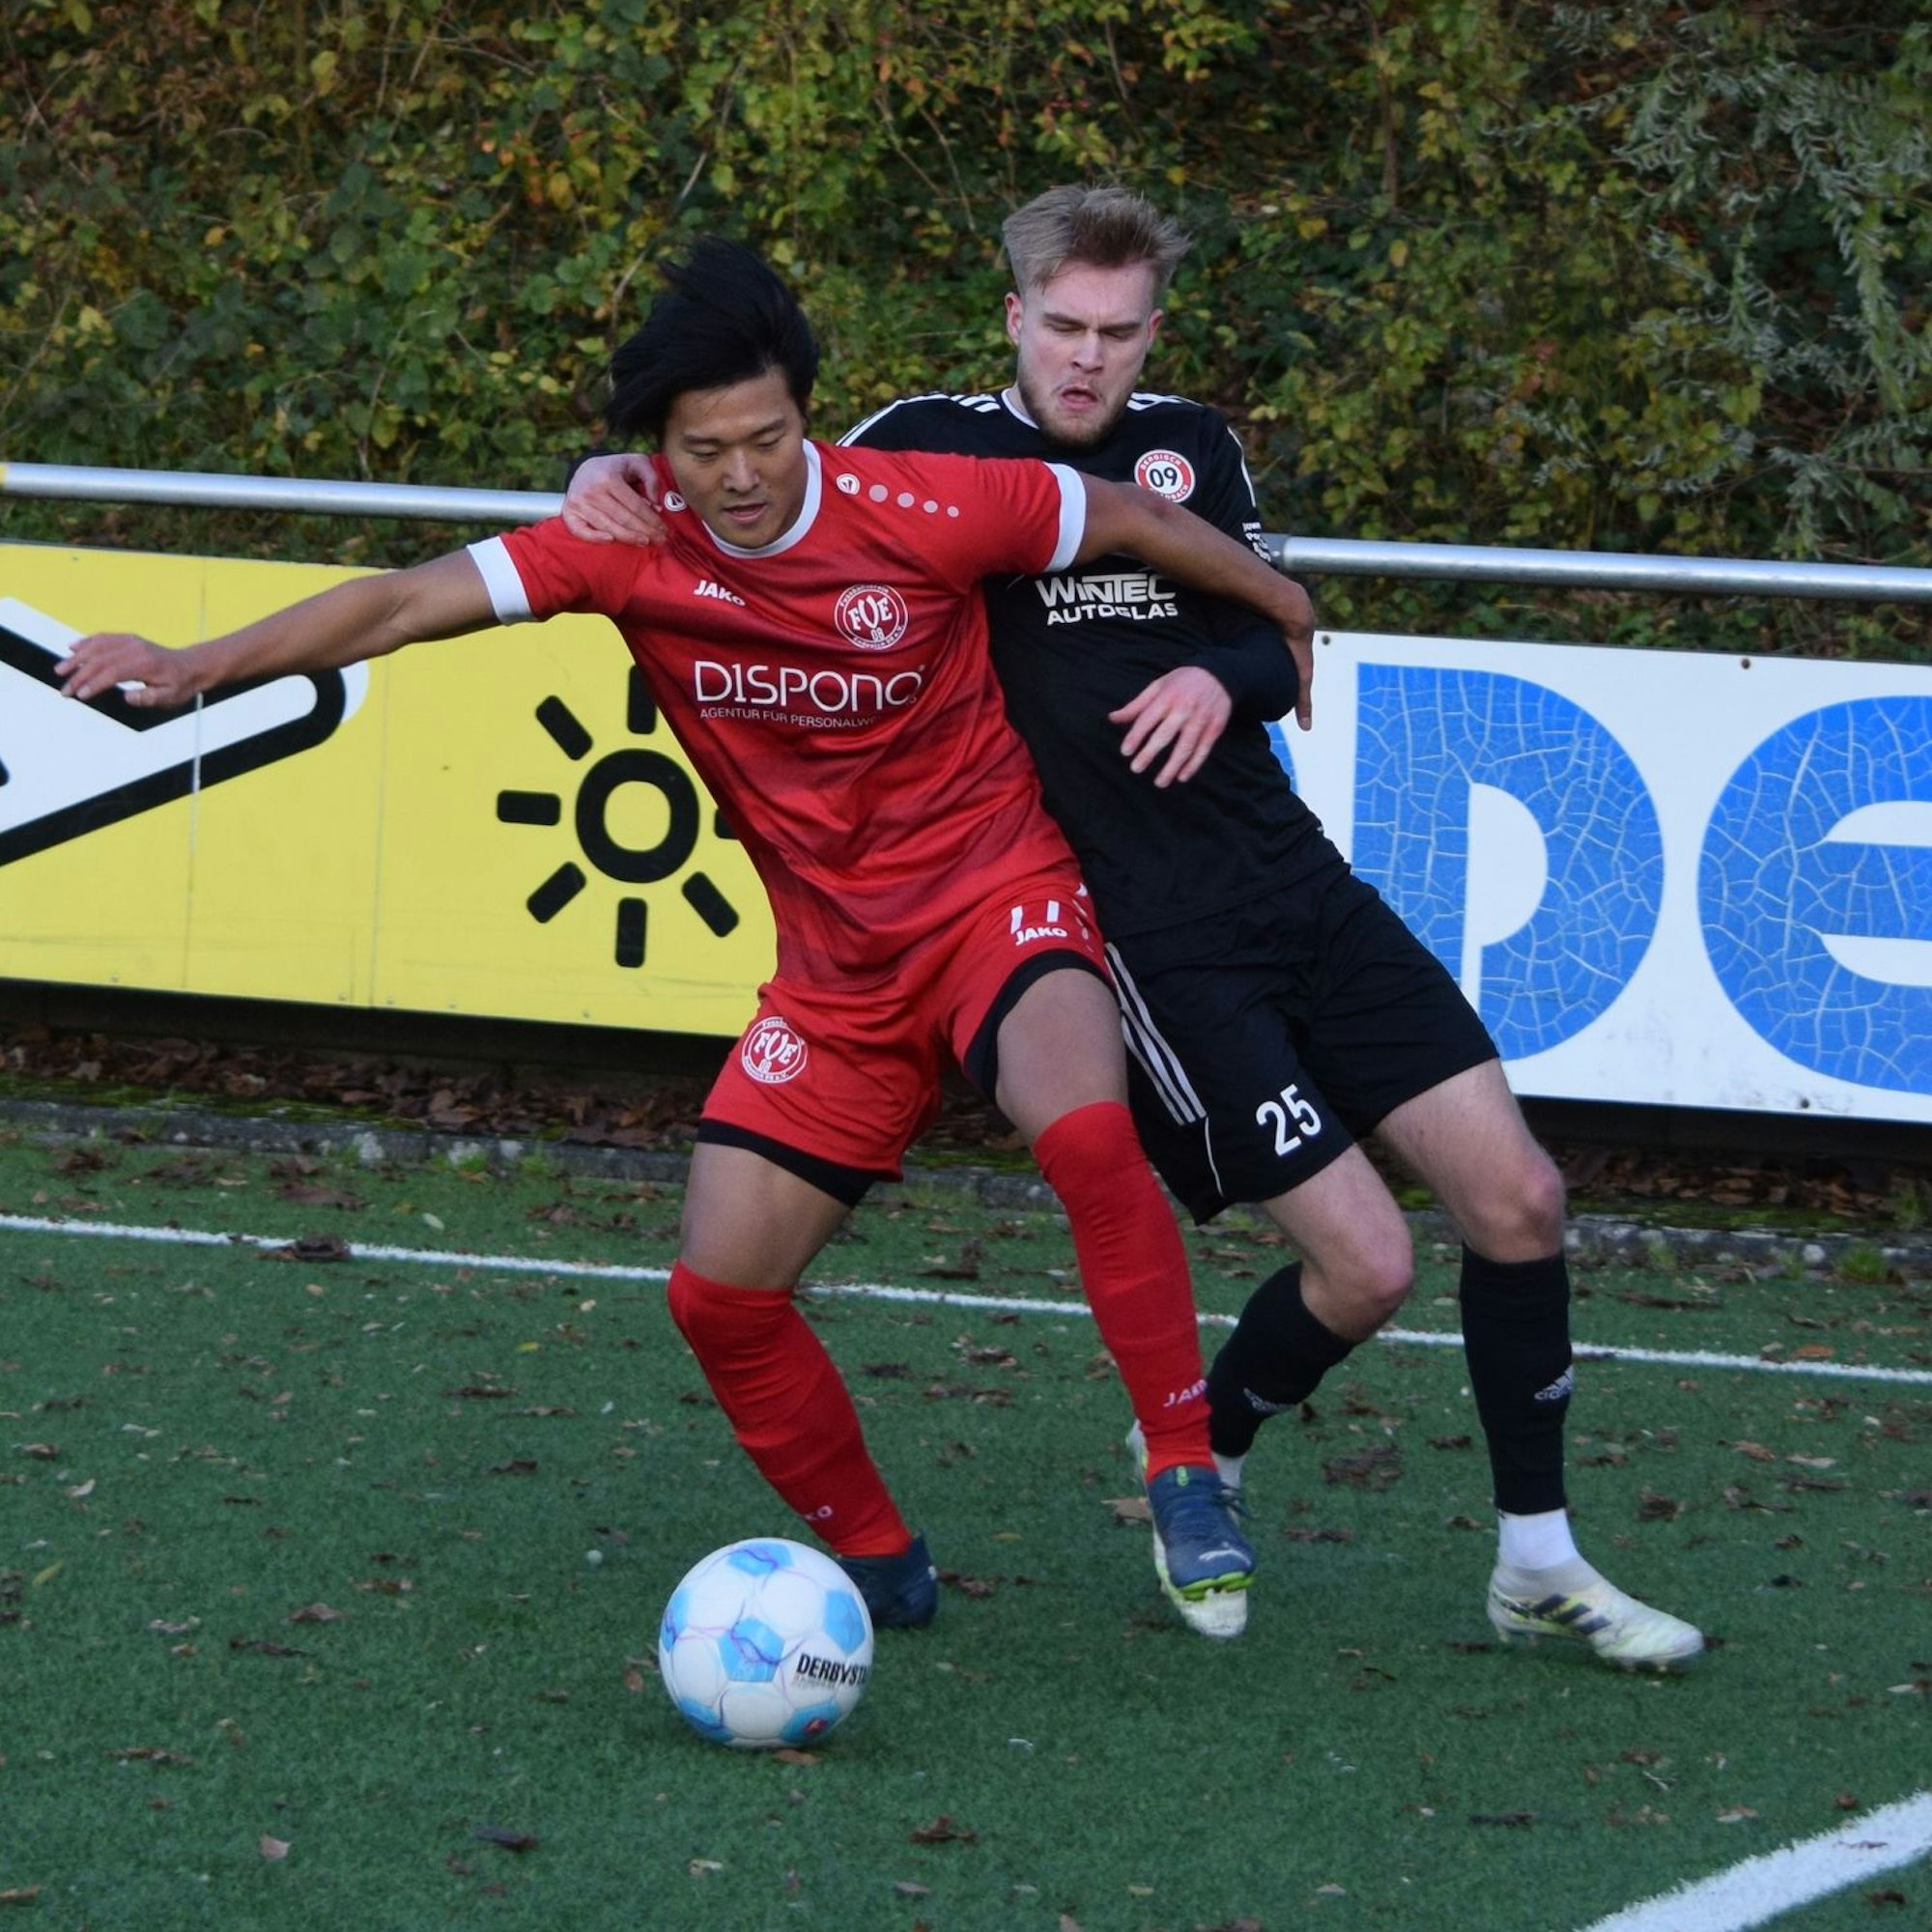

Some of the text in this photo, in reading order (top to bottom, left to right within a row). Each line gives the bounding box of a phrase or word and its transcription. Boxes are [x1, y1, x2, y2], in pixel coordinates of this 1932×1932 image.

[1150, 468, 1178, 488] 09
[693, 580, 747, 607] JAKO
[1047, 603, 1179, 626] AUTOGLAS
[699, 707, 760, 720] AGENTUR
[1015, 927, 1067, 946] JAKO
[1256, 1084, 1321, 1156] 25
